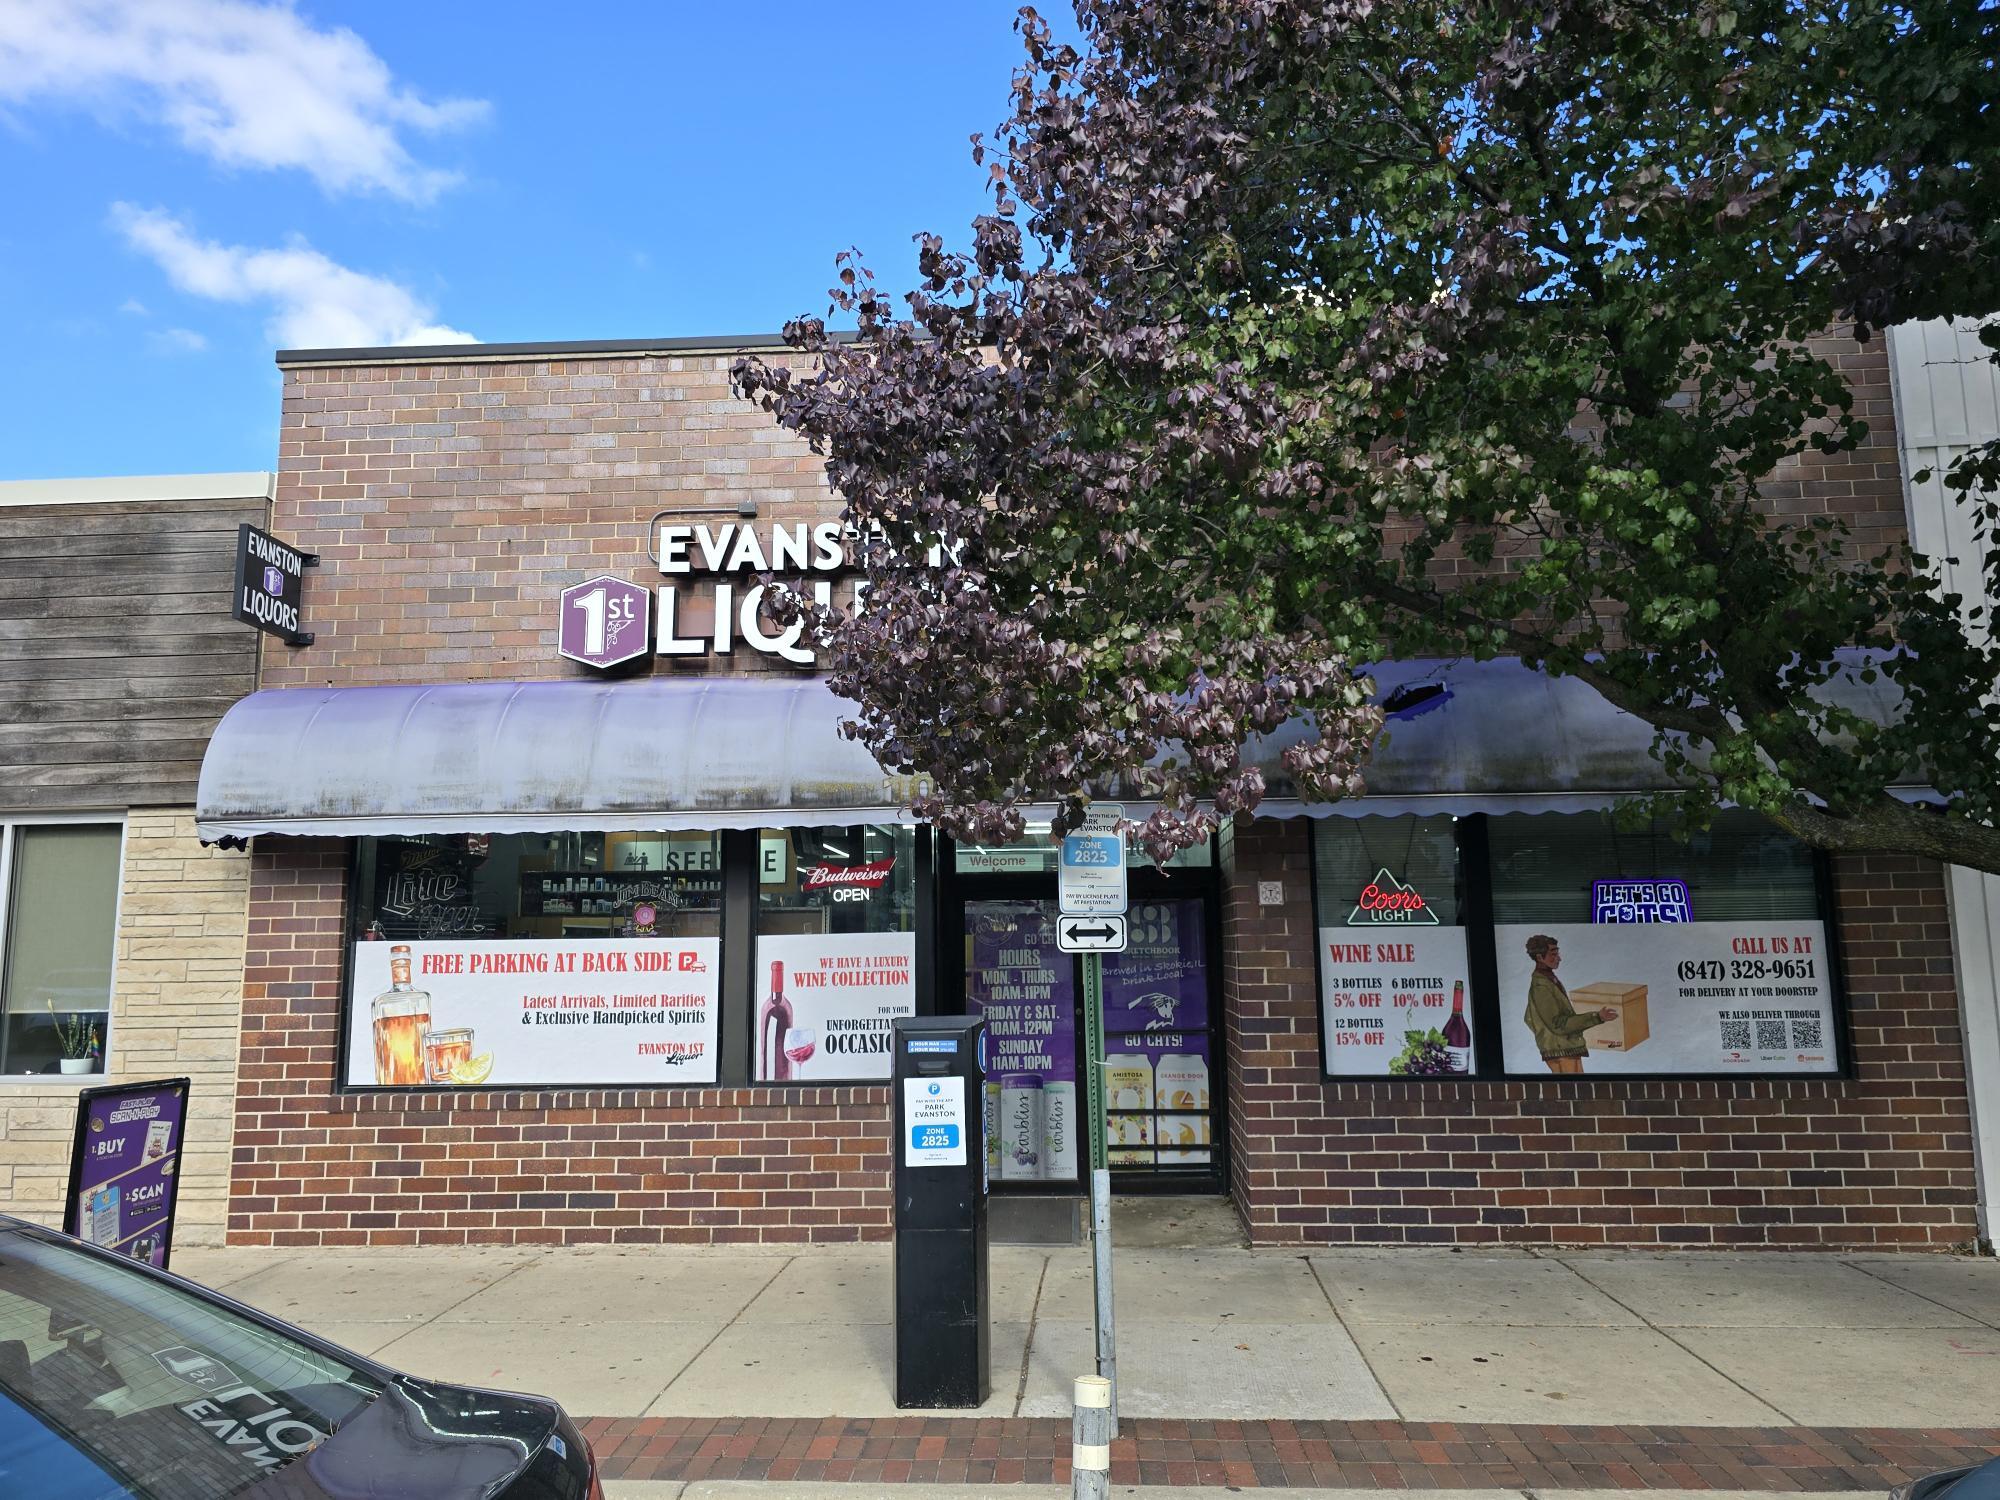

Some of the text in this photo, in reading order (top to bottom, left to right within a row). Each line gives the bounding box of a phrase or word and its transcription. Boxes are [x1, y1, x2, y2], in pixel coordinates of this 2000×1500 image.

[247, 531, 302, 578] EVANSTON
[267, 570, 281, 593] 1st
[242, 585, 298, 632] LIQUORS
[573, 588, 635, 656] 1st
[1079, 841, 1103, 849] ZONE
[969, 855, 1026, 866] Welcome
[1074, 850, 1108, 863] 2825
[806, 866, 890, 885] Budweiser
[381, 868, 459, 916] Lite
[613, 880, 679, 909] JIM BEAM
[832, 887, 870, 903] OPEN
[1359, 884, 1423, 910] Coors
[1597, 883, 1687, 906] LET'S GO
[1370, 909, 1413, 921] LIGHT
[1329, 943, 1415, 963] WINE SALE
[1732, 936, 1812, 954] CALL US AT
[421, 952, 672, 974] FREE PARKING AT BACK SIDE
[819, 955, 909, 969] WE HAVE A LUXURY
[998, 949, 1041, 966] HOURS
[1102, 964, 1137, 976] Brewed
[1139, 961, 1152, 972] in
[1677, 959, 1816, 983] (847) 328-9651
[793, 970, 909, 988] WINE COLLECTION
[982, 970, 1011, 985] MON.
[1021, 969, 1058, 984] THURS.
[1122, 969, 1184, 985] Drink Local
[1333, 978, 1382, 989] 3 BOTTLES
[1391, 977, 1443, 989] 6 BOTTLES
[991, 985, 1051, 1000] 10AM-11PM
[1679, 986, 1818, 997] FOR DELIVERY AT YOUR DOORSTEP
[523, 993, 706, 1010] Latest Arrivals, Limited Rarities
[1334, 993, 1382, 1008] 5% OFF
[1392, 993, 1445, 1008] 10% OFF
[521, 1009, 706, 1026] & Exclusive Handpicked Spirits
[878, 1006, 909, 1014] FOR YOUR
[982, 1004, 1061, 1020] FRIDAY & SAT.
[1718, 1009, 1821, 1019] WE ALSO DELIVER THROUGH
[826, 1018, 891, 1031] UNFORGETTA
[989, 1020, 1053, 1036] 10AM-12PM
[1335, 1018, 1384, 1029] 12 BOTTLES
[1124, 1034, 1141, 1047] GO
[1336, 1032, 1384, 1045] 15% OFF
[638, 1042, 705, 1056] EVANSTON 1ST
[998, 1039, 1044, 1055] SUNDAY
[665, 1051, 703, 1066] Liquor
[991, 1055, 1052, 1070] 11AM-10PM
[925, 1127, 945, 1135] ZONE
[98, 1138, 126, 1156] BUY
[921, 1136, 950, 1147] 2825
[131, 1183, 164, 1202] SCAN
